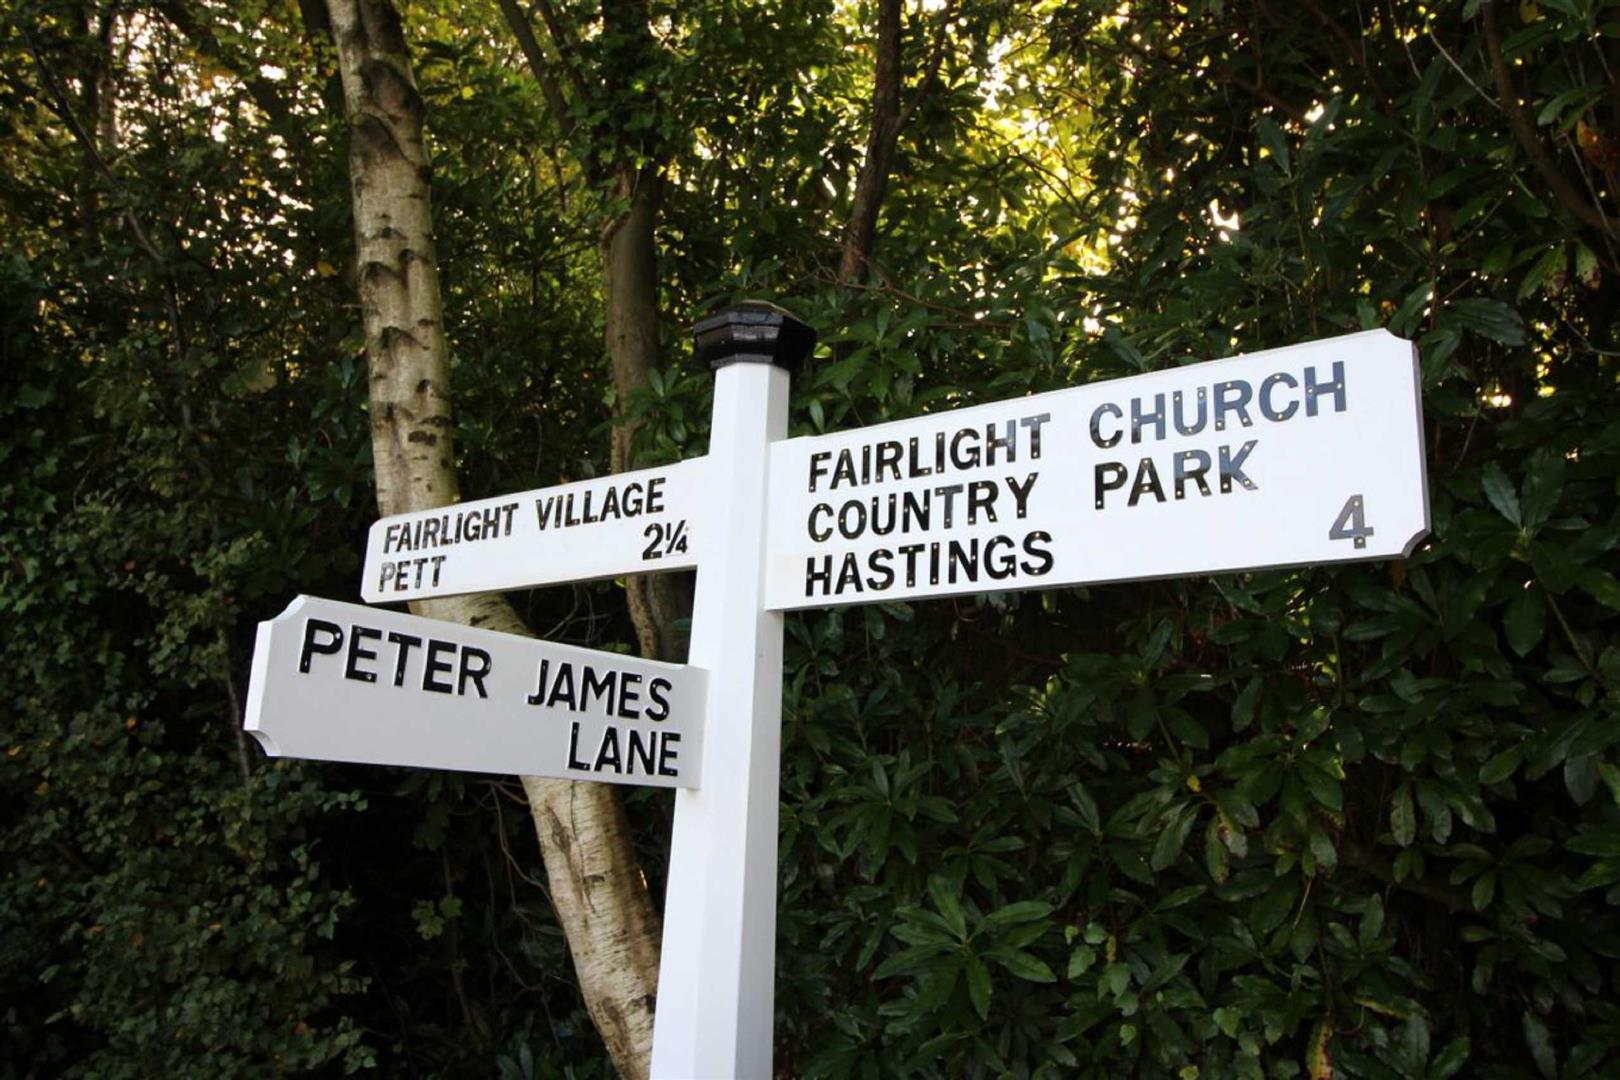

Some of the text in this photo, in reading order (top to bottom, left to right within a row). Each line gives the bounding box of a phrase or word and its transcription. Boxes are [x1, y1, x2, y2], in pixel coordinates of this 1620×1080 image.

[809, 361, 1346, 493] FAIRLIGHT CHURCH
[384, 477, 666, 554] FAIRLIGHT VILLAGE
[808, 440, 1258, 542] COUNTRY PARK
[379, 555, 446, 592] PETT
[805, 495, 1374, 597] HASTINGS 4
[300, 619, 672, 722] PETER JAMES
[568, 722, 681, 777] LANE
